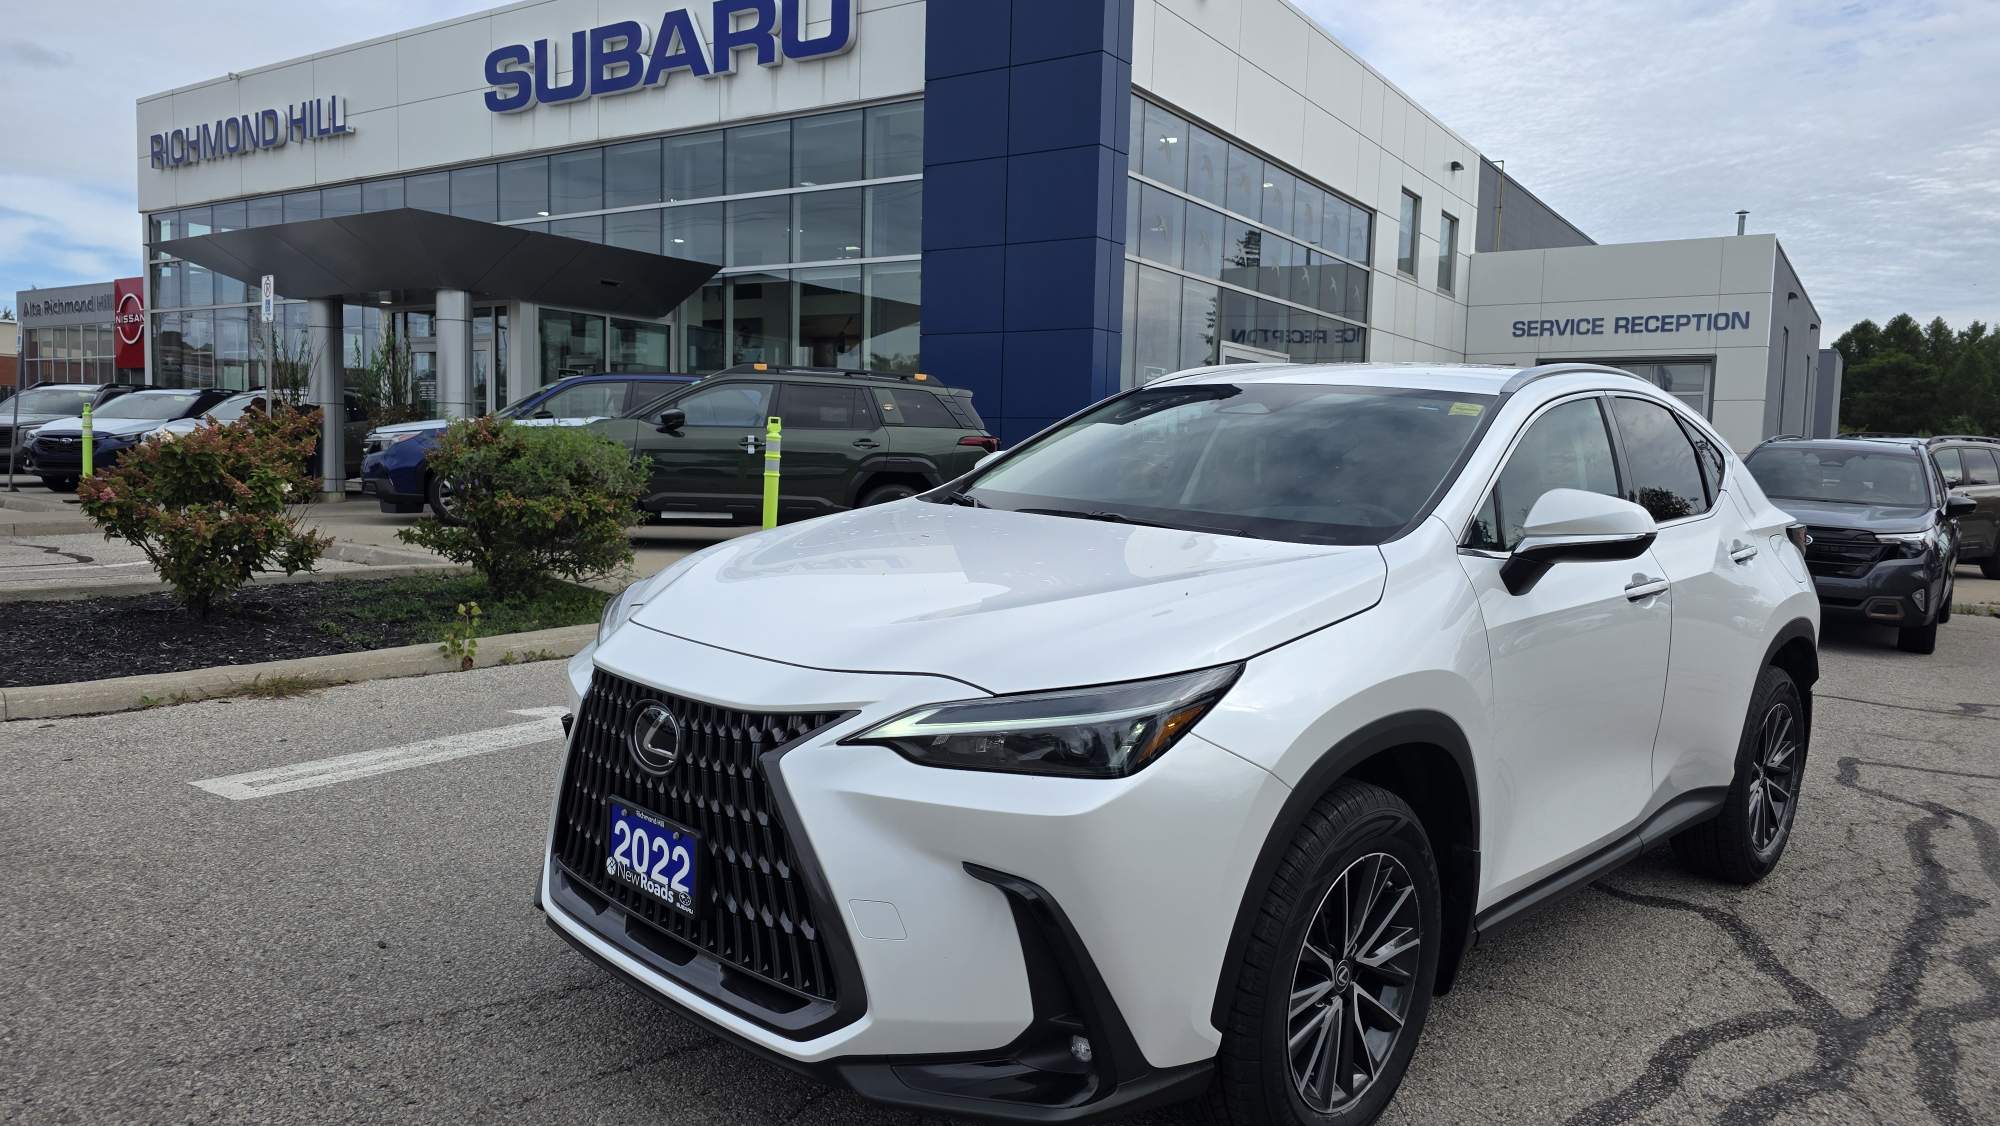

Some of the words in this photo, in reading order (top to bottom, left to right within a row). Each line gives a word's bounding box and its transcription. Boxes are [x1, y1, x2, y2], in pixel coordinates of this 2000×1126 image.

[484, 0, 853, 113] SUBARU
[150, 108, 286, 169] RICHMOND
[289, 95, 347, 143] HILL
[23, 301, 42, 318] Alta
[44, 297, 94, 316] Richmond
[1512, 317, 1605, 337] SERVICE
[1613, 310, 1751, 334] RECEPTION
[613, 820, 690, 893] 2022
